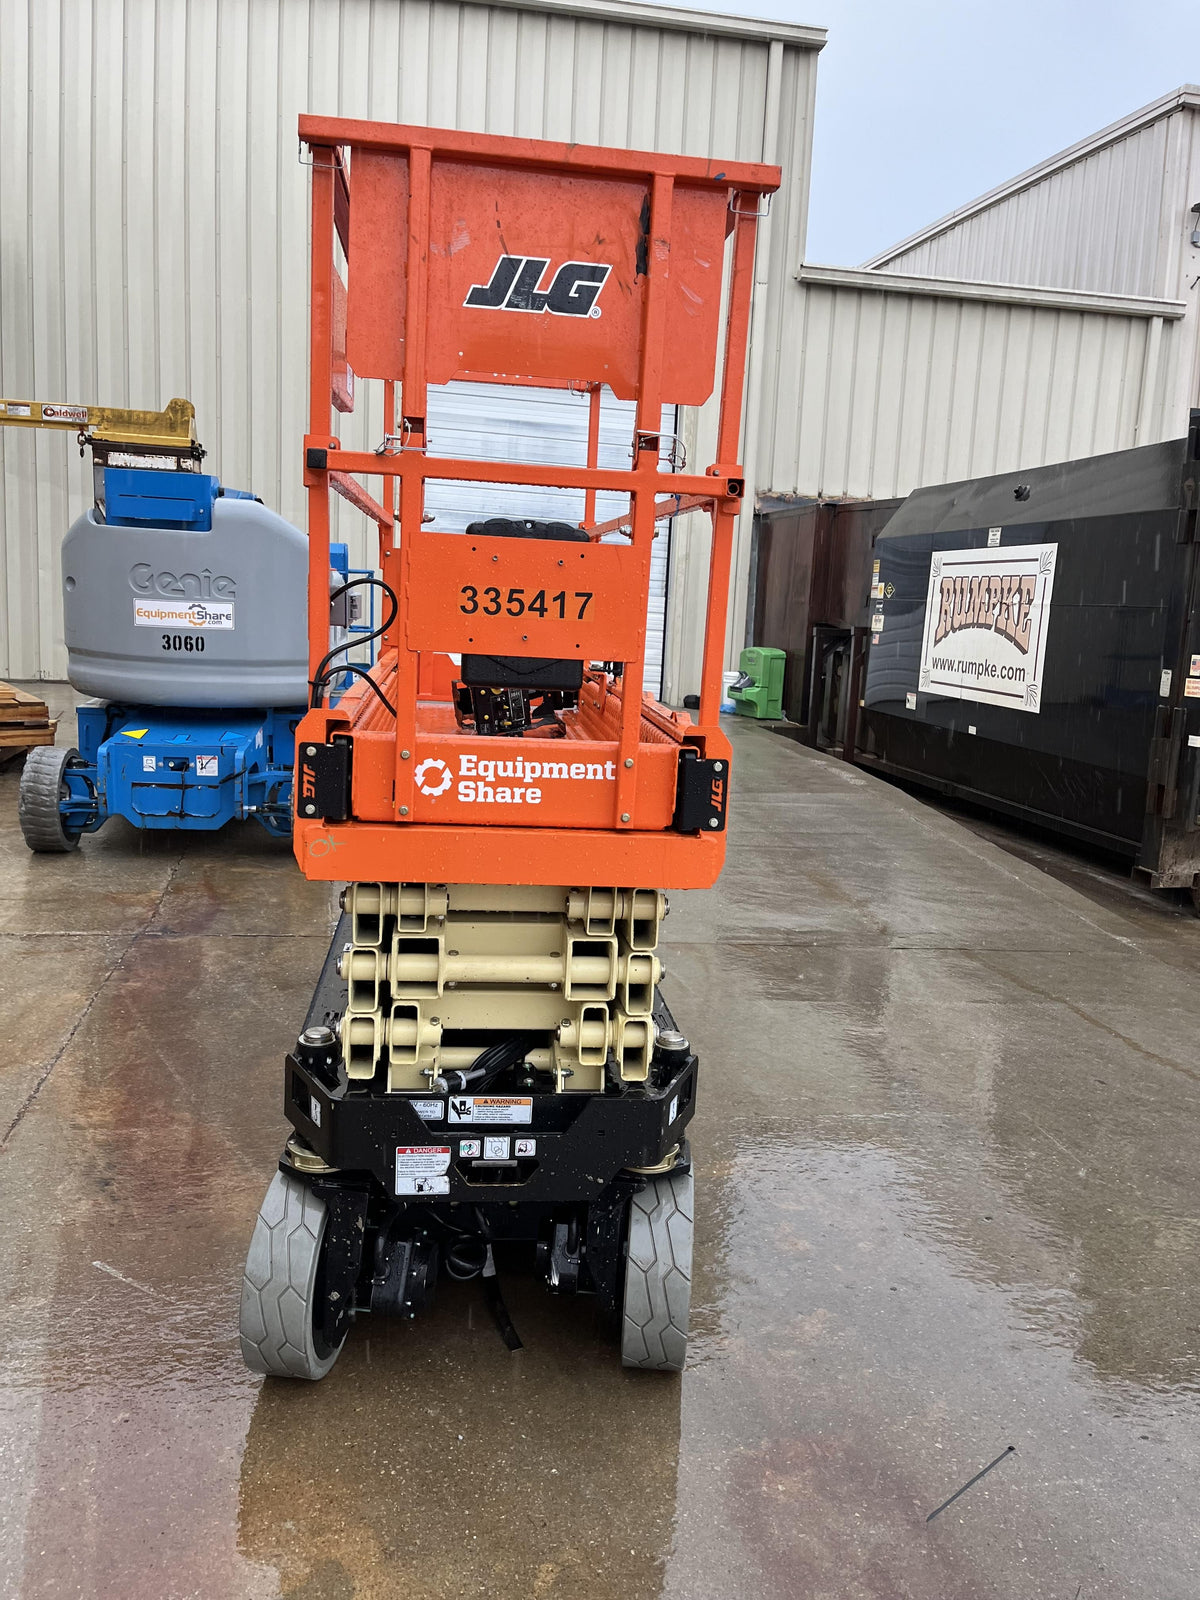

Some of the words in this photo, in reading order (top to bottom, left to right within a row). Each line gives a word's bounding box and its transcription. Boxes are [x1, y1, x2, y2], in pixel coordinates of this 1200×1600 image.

[462, 254, 613, 318] JLG
[43, 406, 87, 418] Caldwell
[128, 562, 236, 600] Genie
[459, 585, 593, 620] 335417
[933, 575, 1037, 655] RUMPKE
[162, 634, 205, 652] 3060
[931, 657, 1026, 682] www.rumpke.com
[302, 763, 316, 799] JLG
[458, 754, 616, 783] Equipment
[457, 781, 542, 804] Share
[710, 779, 724, 813] JLG
